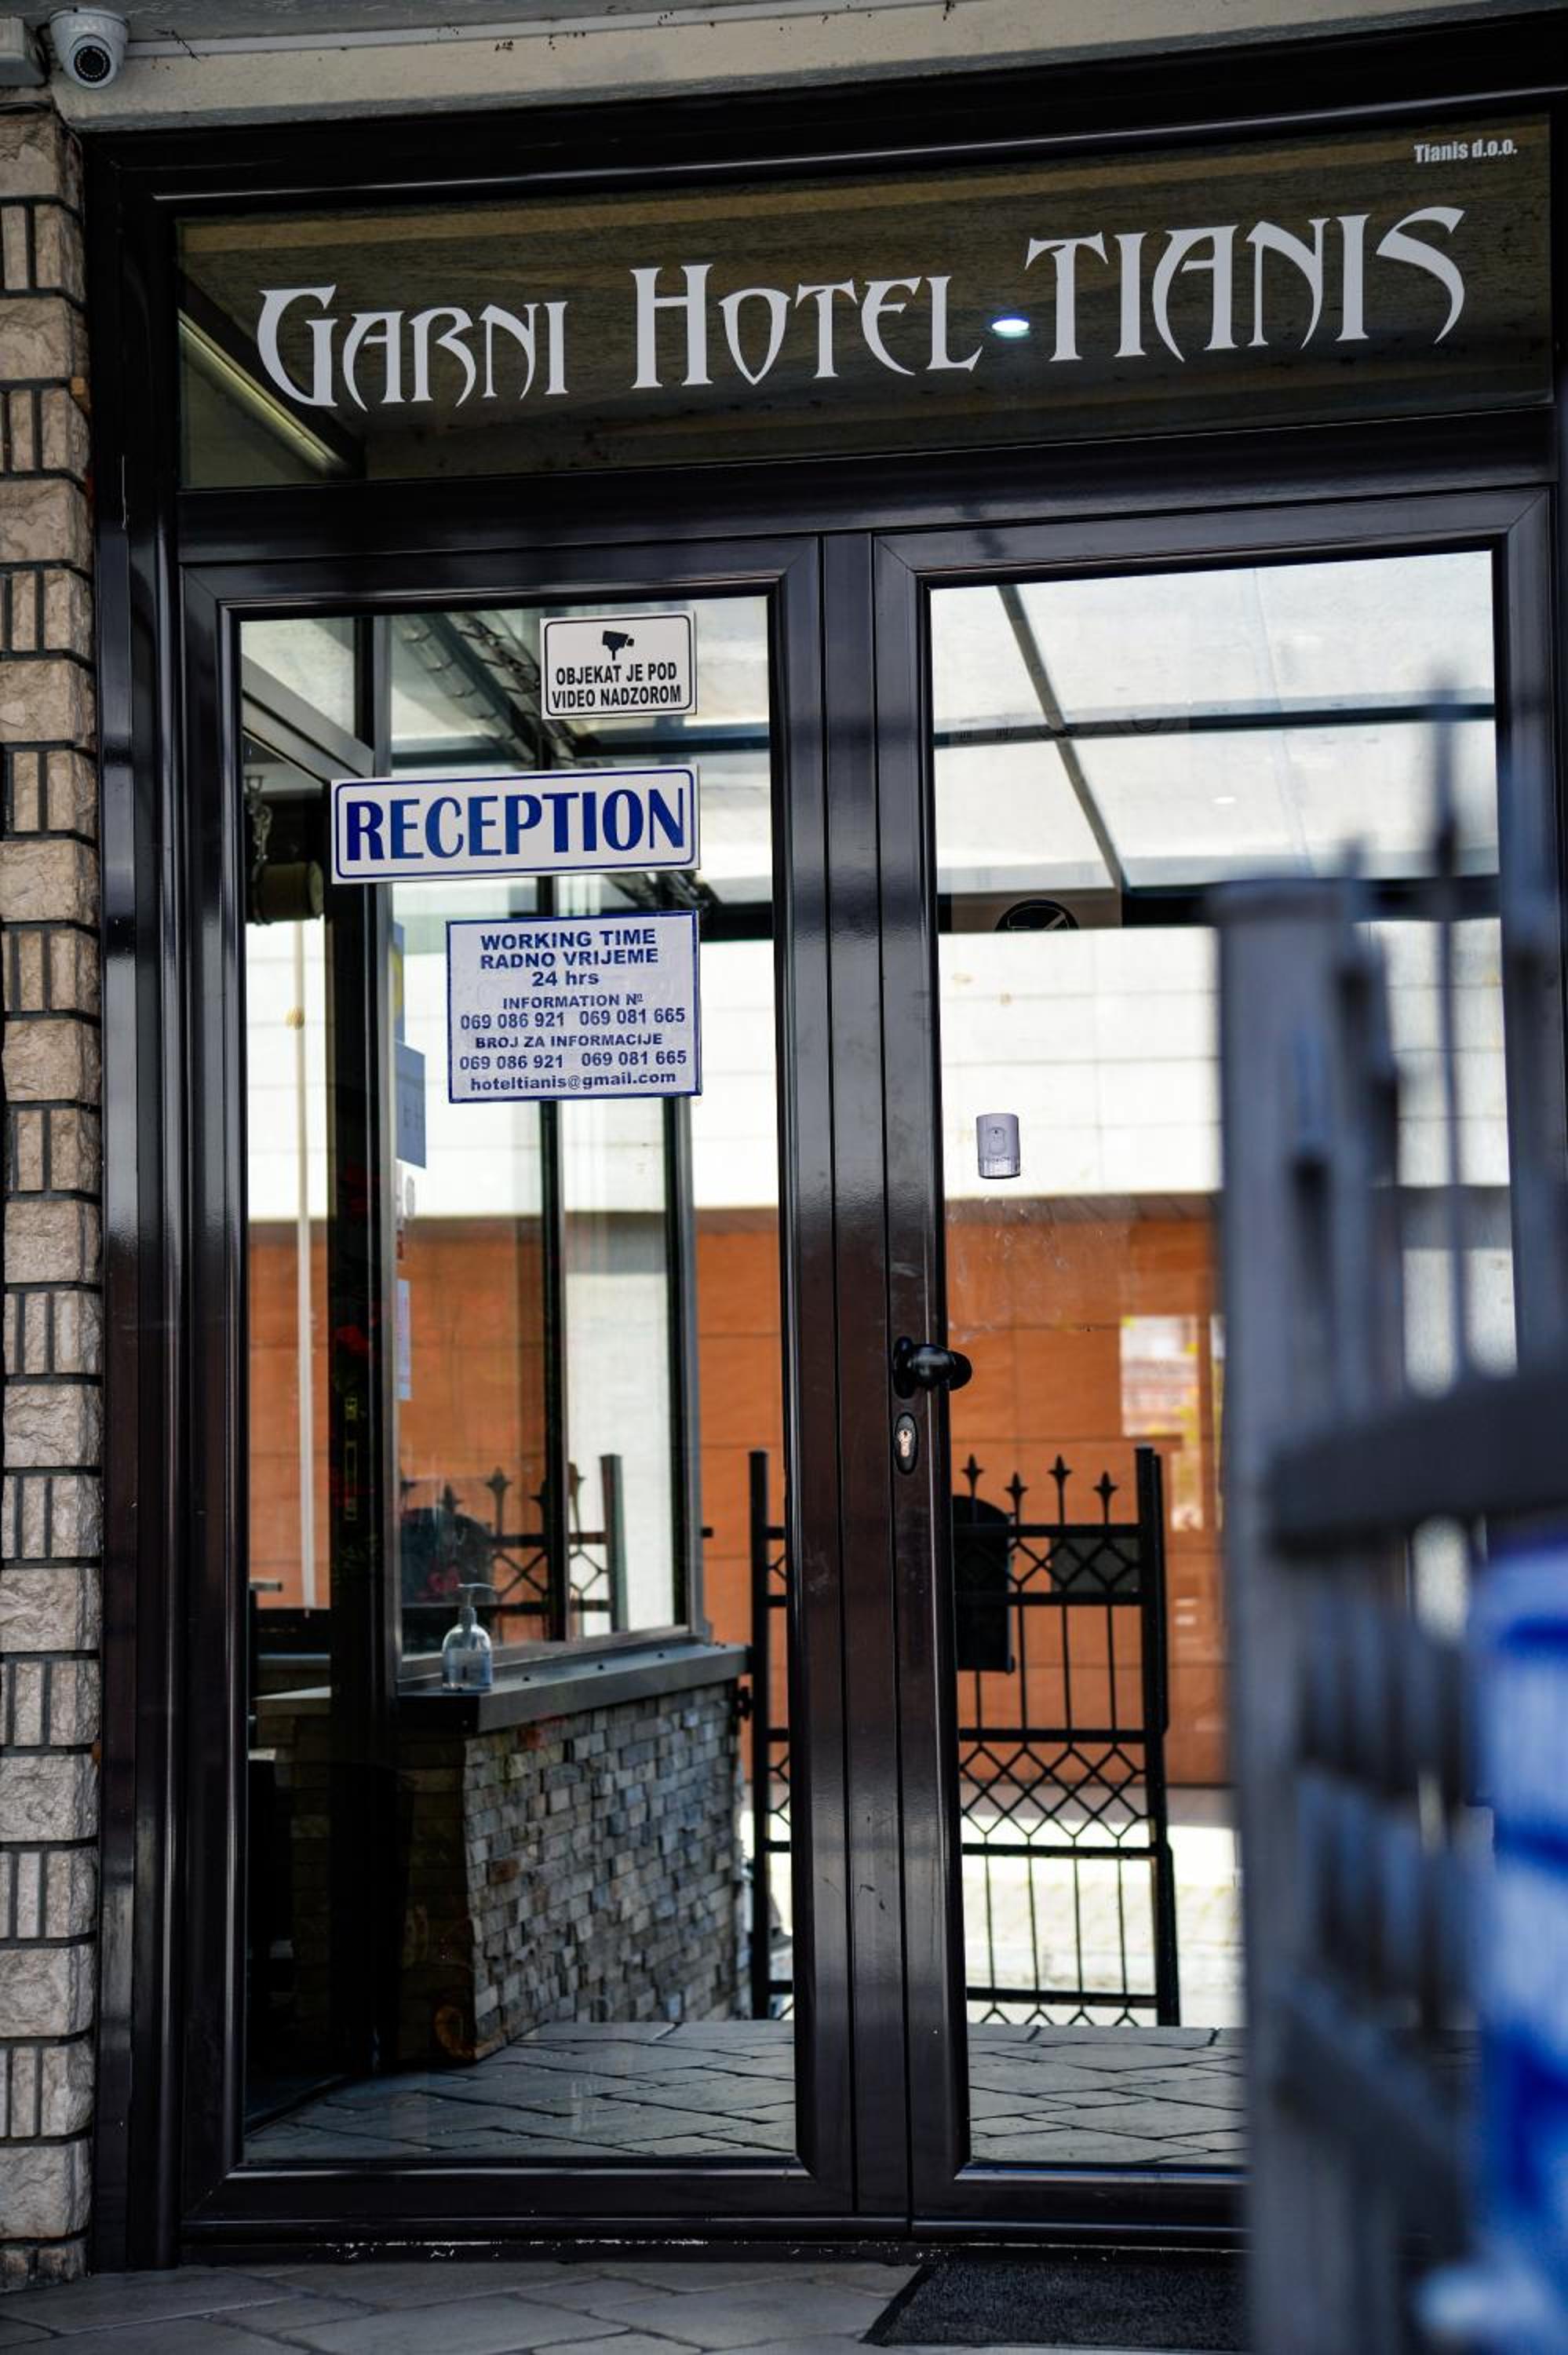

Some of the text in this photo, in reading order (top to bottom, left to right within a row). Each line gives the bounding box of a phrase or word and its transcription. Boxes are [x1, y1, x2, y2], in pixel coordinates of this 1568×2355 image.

[1414, 139, 1518, 163] Tianis d.o.o.
[257, 206, 1465, 411] GARNI HOTEL TIANIS
[556, 662, 677, 685] OBJEKAT JE POD
[552, 684, 682, 709] VIDEO NADZOROM
[346, 787, 684, 861] RECEPTION
[480, 929, 657, 951] WORKING TIME
[481, 947, 658, 969] RADNO VRIJEME
[532, 971, 600, 988] 24 hrs
[503, 994, 620, 1010] INFORMATION
[461, 1007, 685, 1031] 069 086 921 069 081 665
[476, 1032, 662, 1050] BROJ ZA INFORMACIJE
[460, 1050, 687, 1070] 069 086 921 069 081 665
[471, 1072, 676, 1091] hoteltianis@gmail.com
